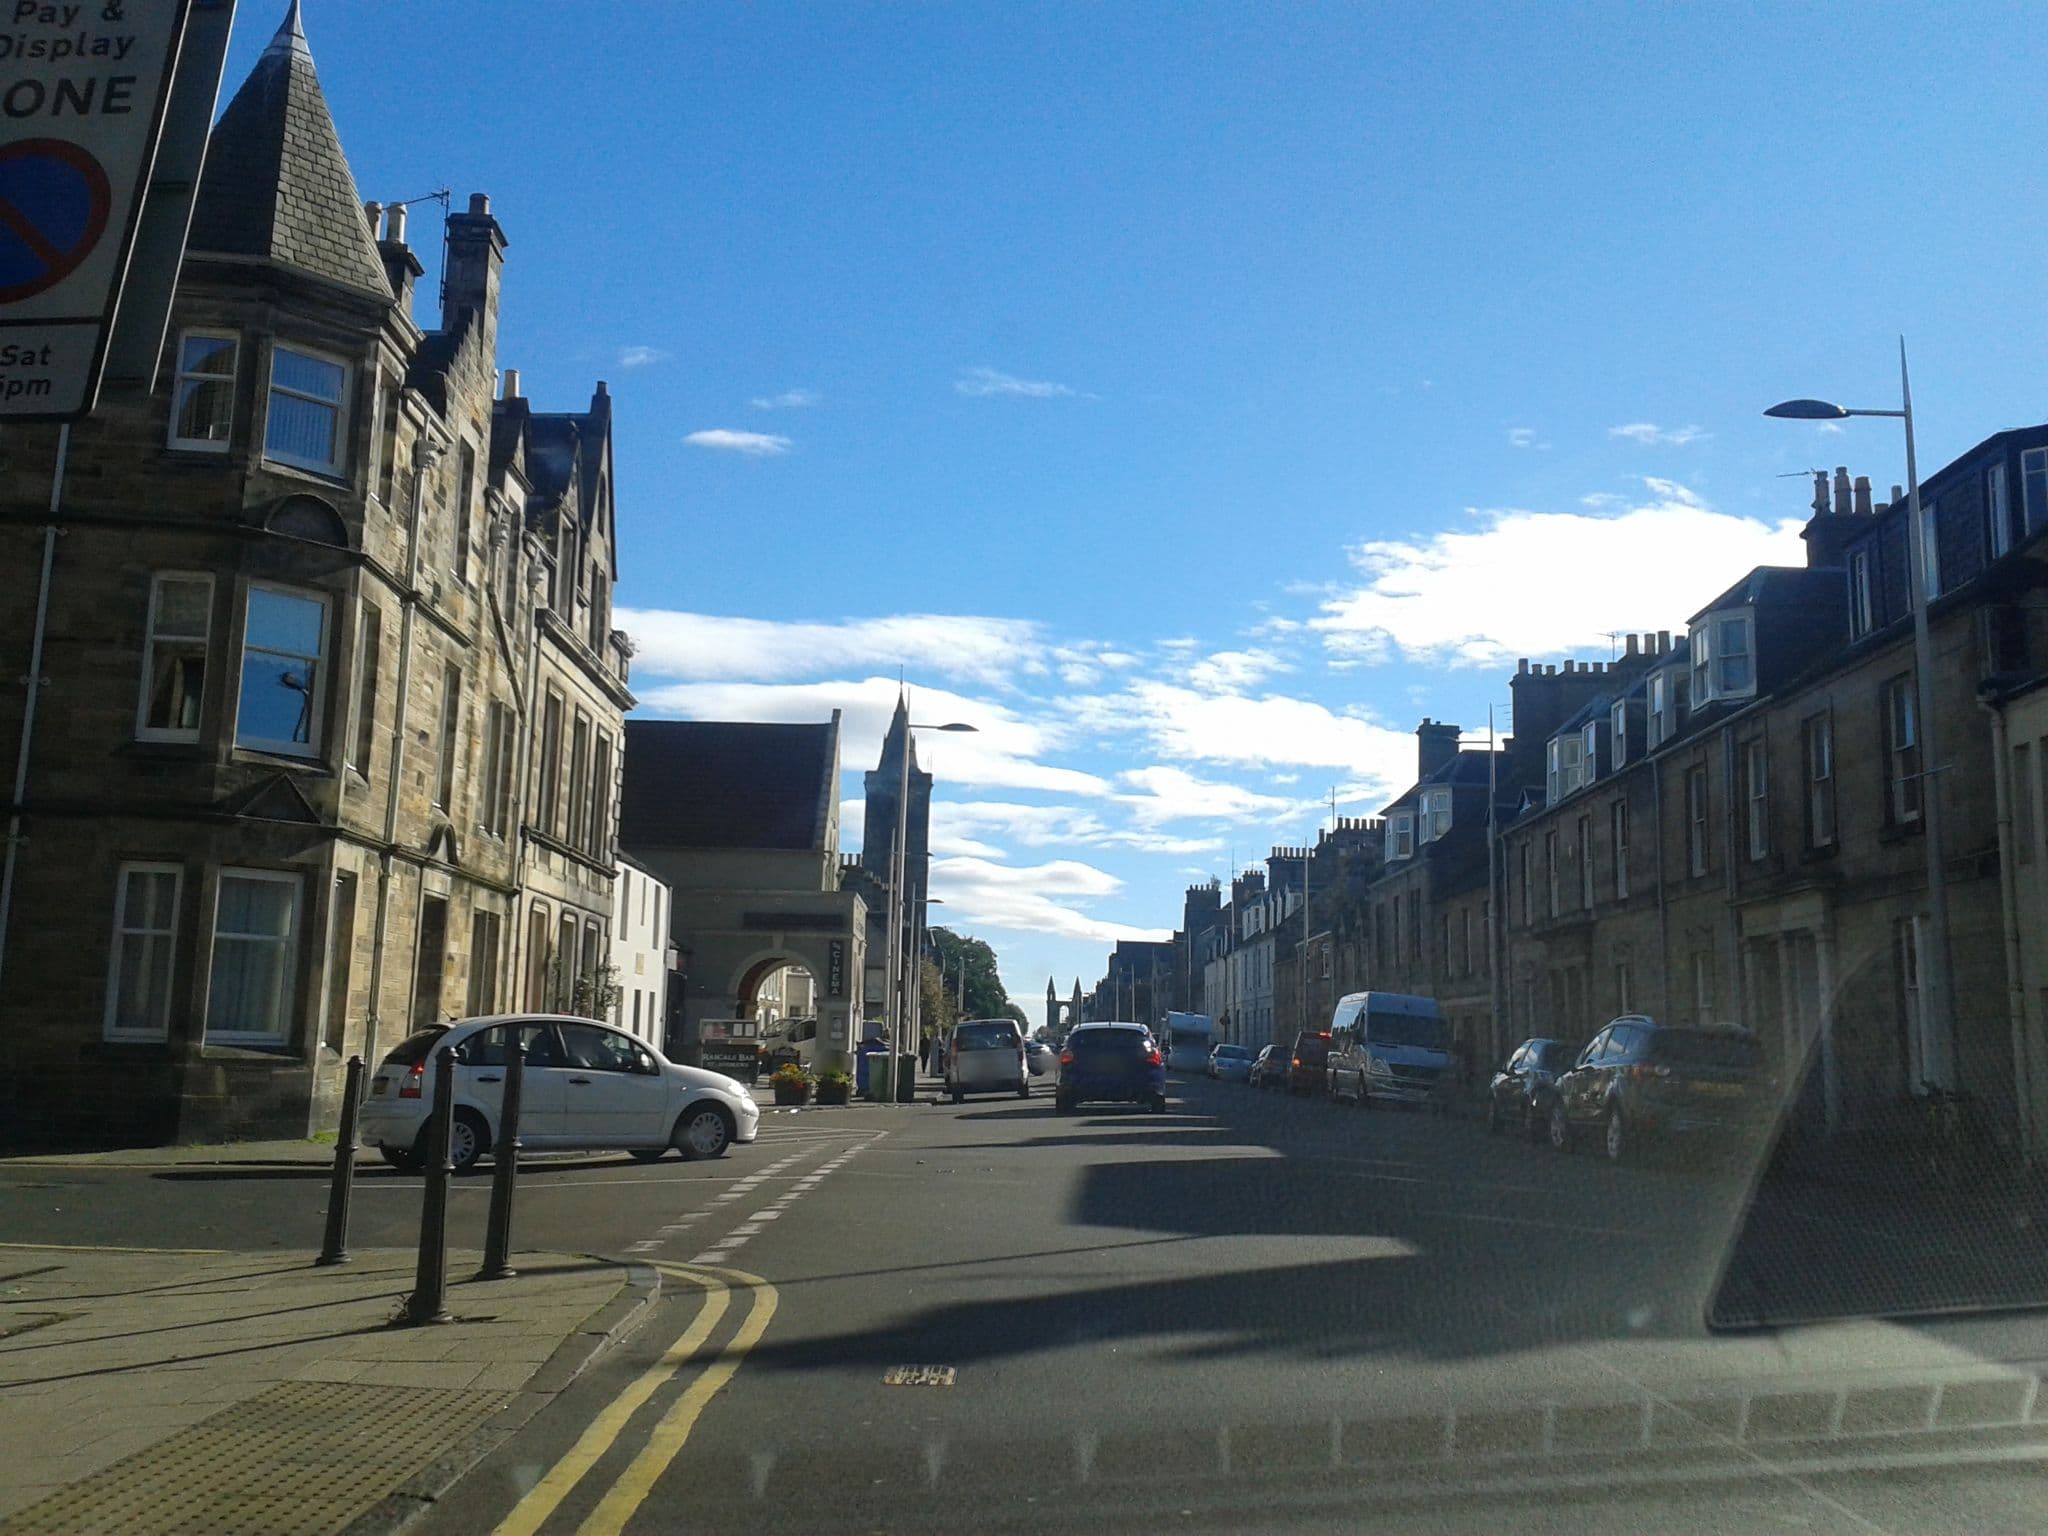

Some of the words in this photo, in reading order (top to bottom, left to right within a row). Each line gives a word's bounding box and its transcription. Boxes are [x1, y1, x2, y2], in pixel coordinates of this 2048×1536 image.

[13, 0, 80, 28] Pay
[101, 0, 125, 21] &
[0, 342, 51, 366] Sat
[831, 951, 841, 994] CINEMA
